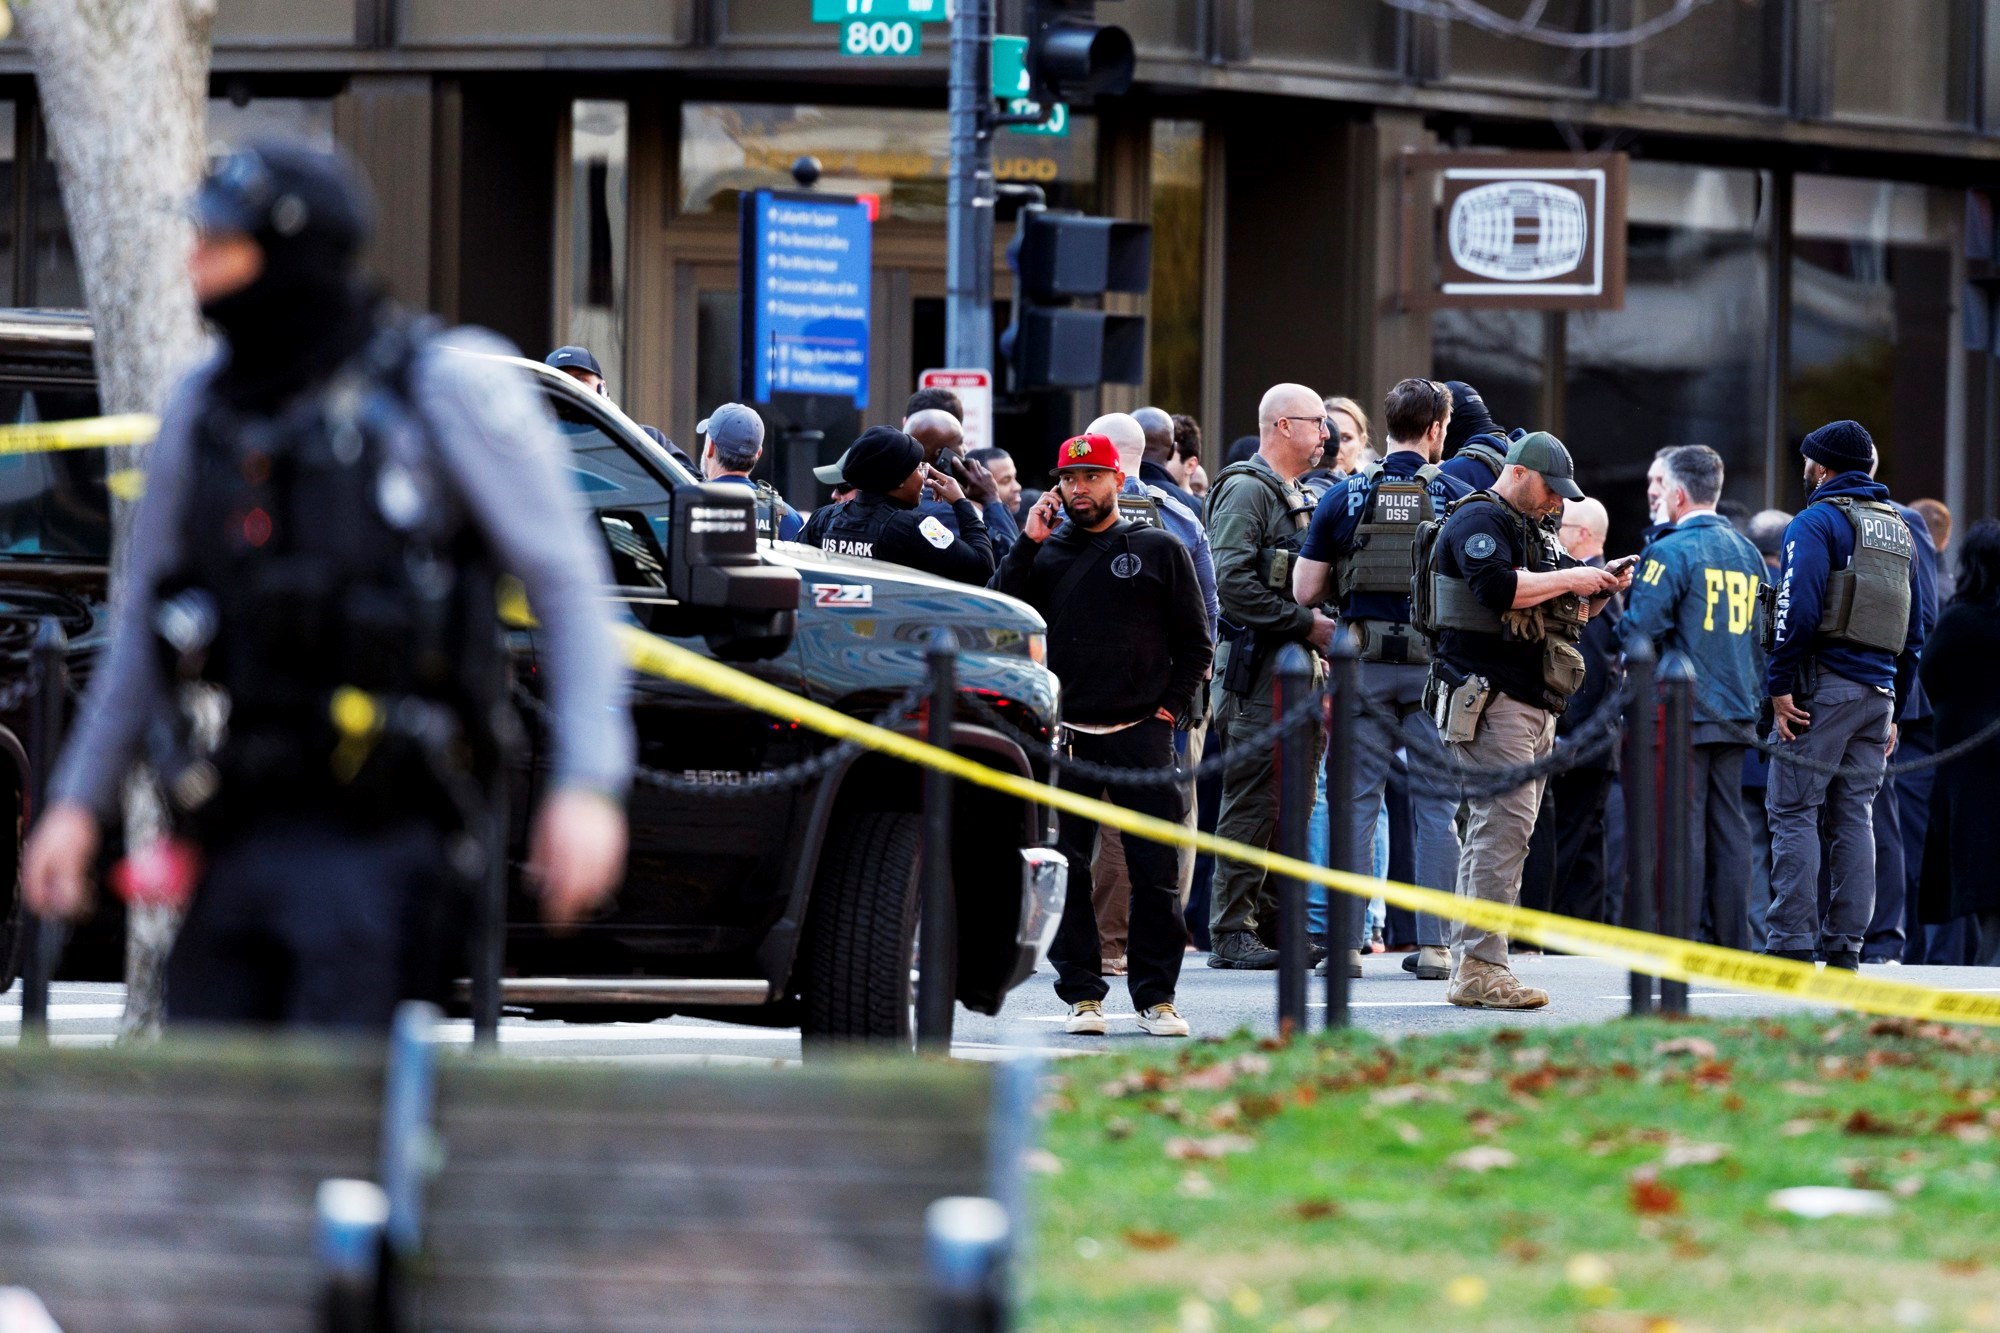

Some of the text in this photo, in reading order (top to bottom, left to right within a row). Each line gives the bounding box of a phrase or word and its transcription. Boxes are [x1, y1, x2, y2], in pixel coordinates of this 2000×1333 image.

[847, 21, 914, 54] 800
[1378, 494, 1420, 507] POLICE
[1386, 508, 1409, 521] DSS
[822, 538, 874, 557] US PARK
[1636, 559, 1666, 587] BI
[812, 584, 874, 608] Z71
